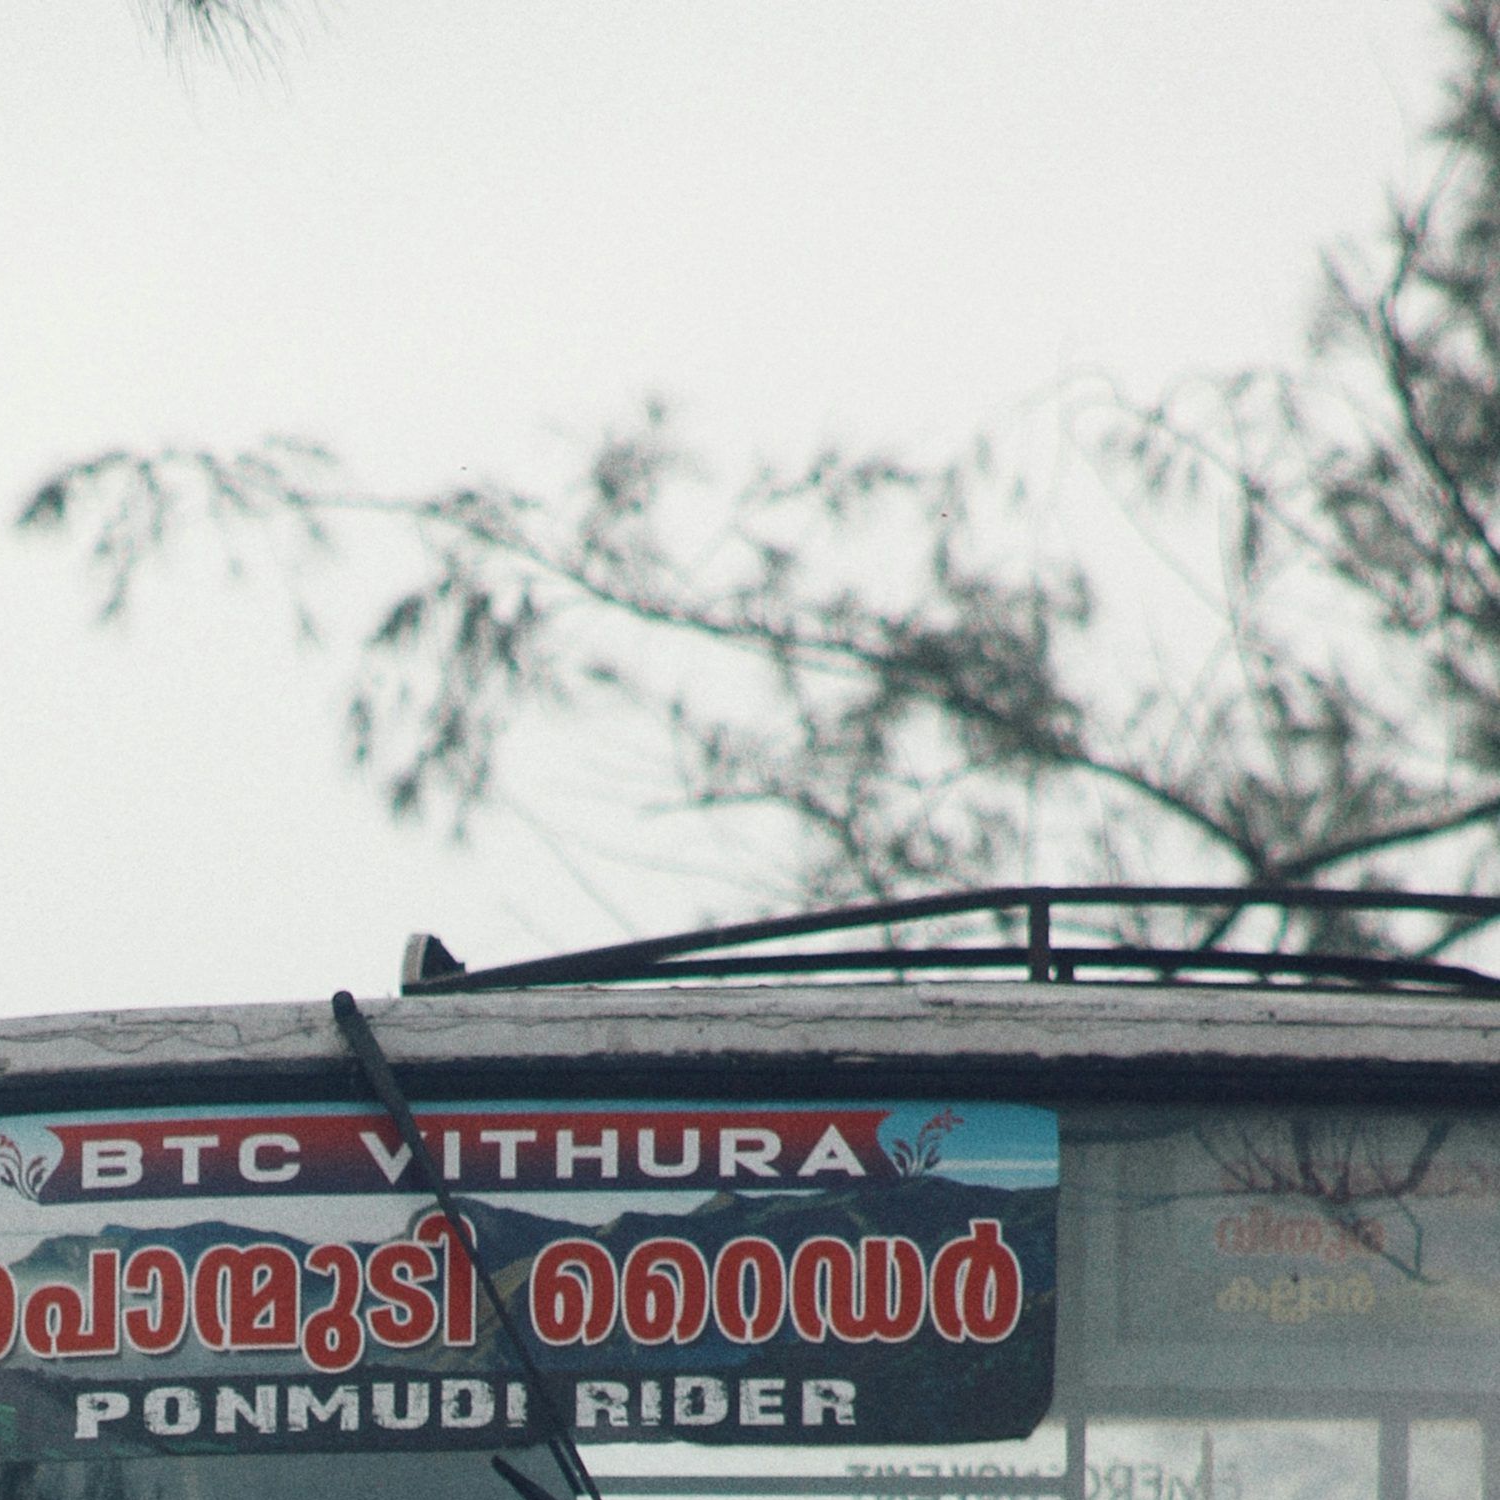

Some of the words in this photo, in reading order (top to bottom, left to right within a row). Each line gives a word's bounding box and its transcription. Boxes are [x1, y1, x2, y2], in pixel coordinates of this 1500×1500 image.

[81, 1132, 301, 1190] BTC
[360, 1122, 867, 1186] VITHURA
[74, 1377, 529, 1440] PONMUDI
[575, 1376, 857, 1429] RIDER
